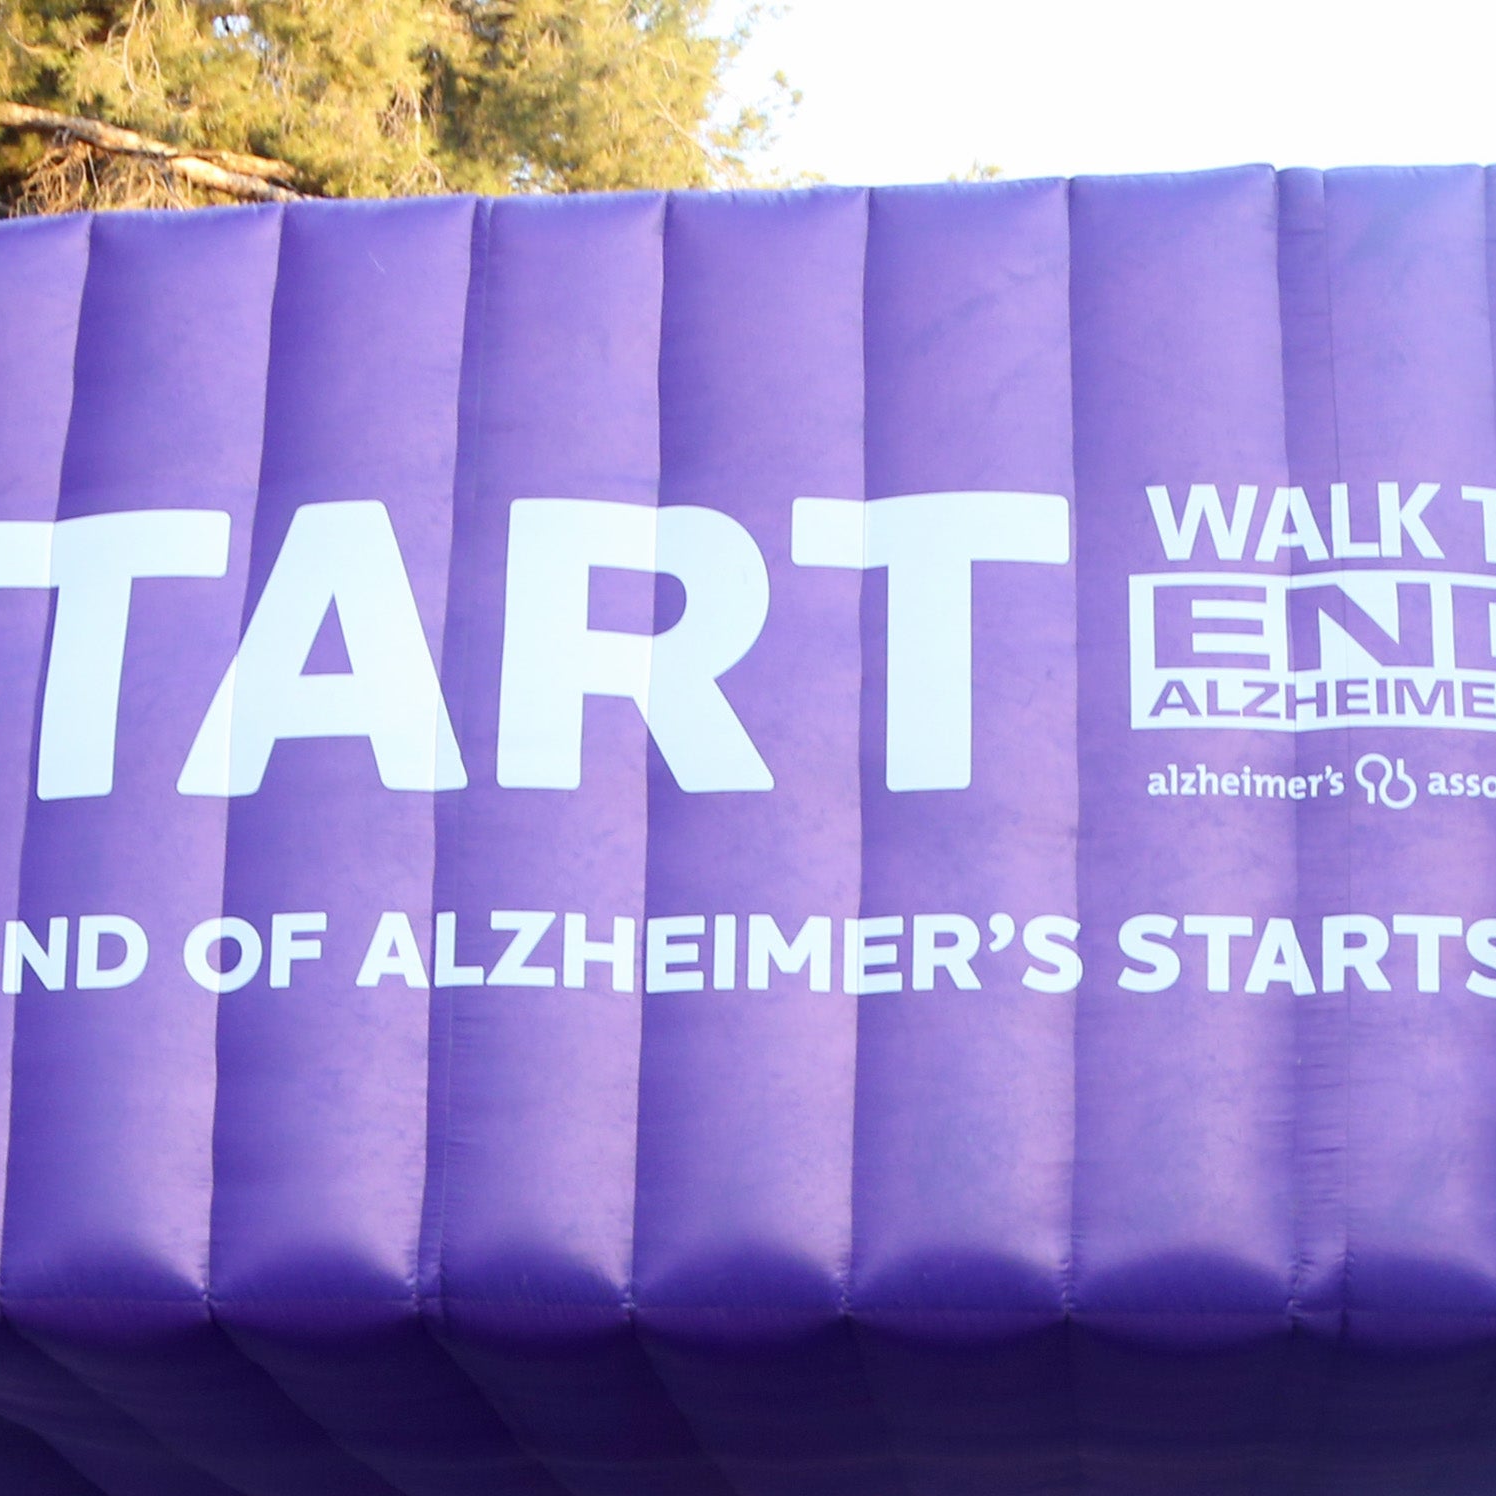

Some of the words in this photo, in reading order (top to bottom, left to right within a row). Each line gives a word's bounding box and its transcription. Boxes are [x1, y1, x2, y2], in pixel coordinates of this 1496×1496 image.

[1145, 481, 1446, 563] WALK
[1146, 763, 1345, 800] alzheimer's
[182, 912, 328, 994] OF
[355, 910, 1083, 995] ALZHEIMER'S
